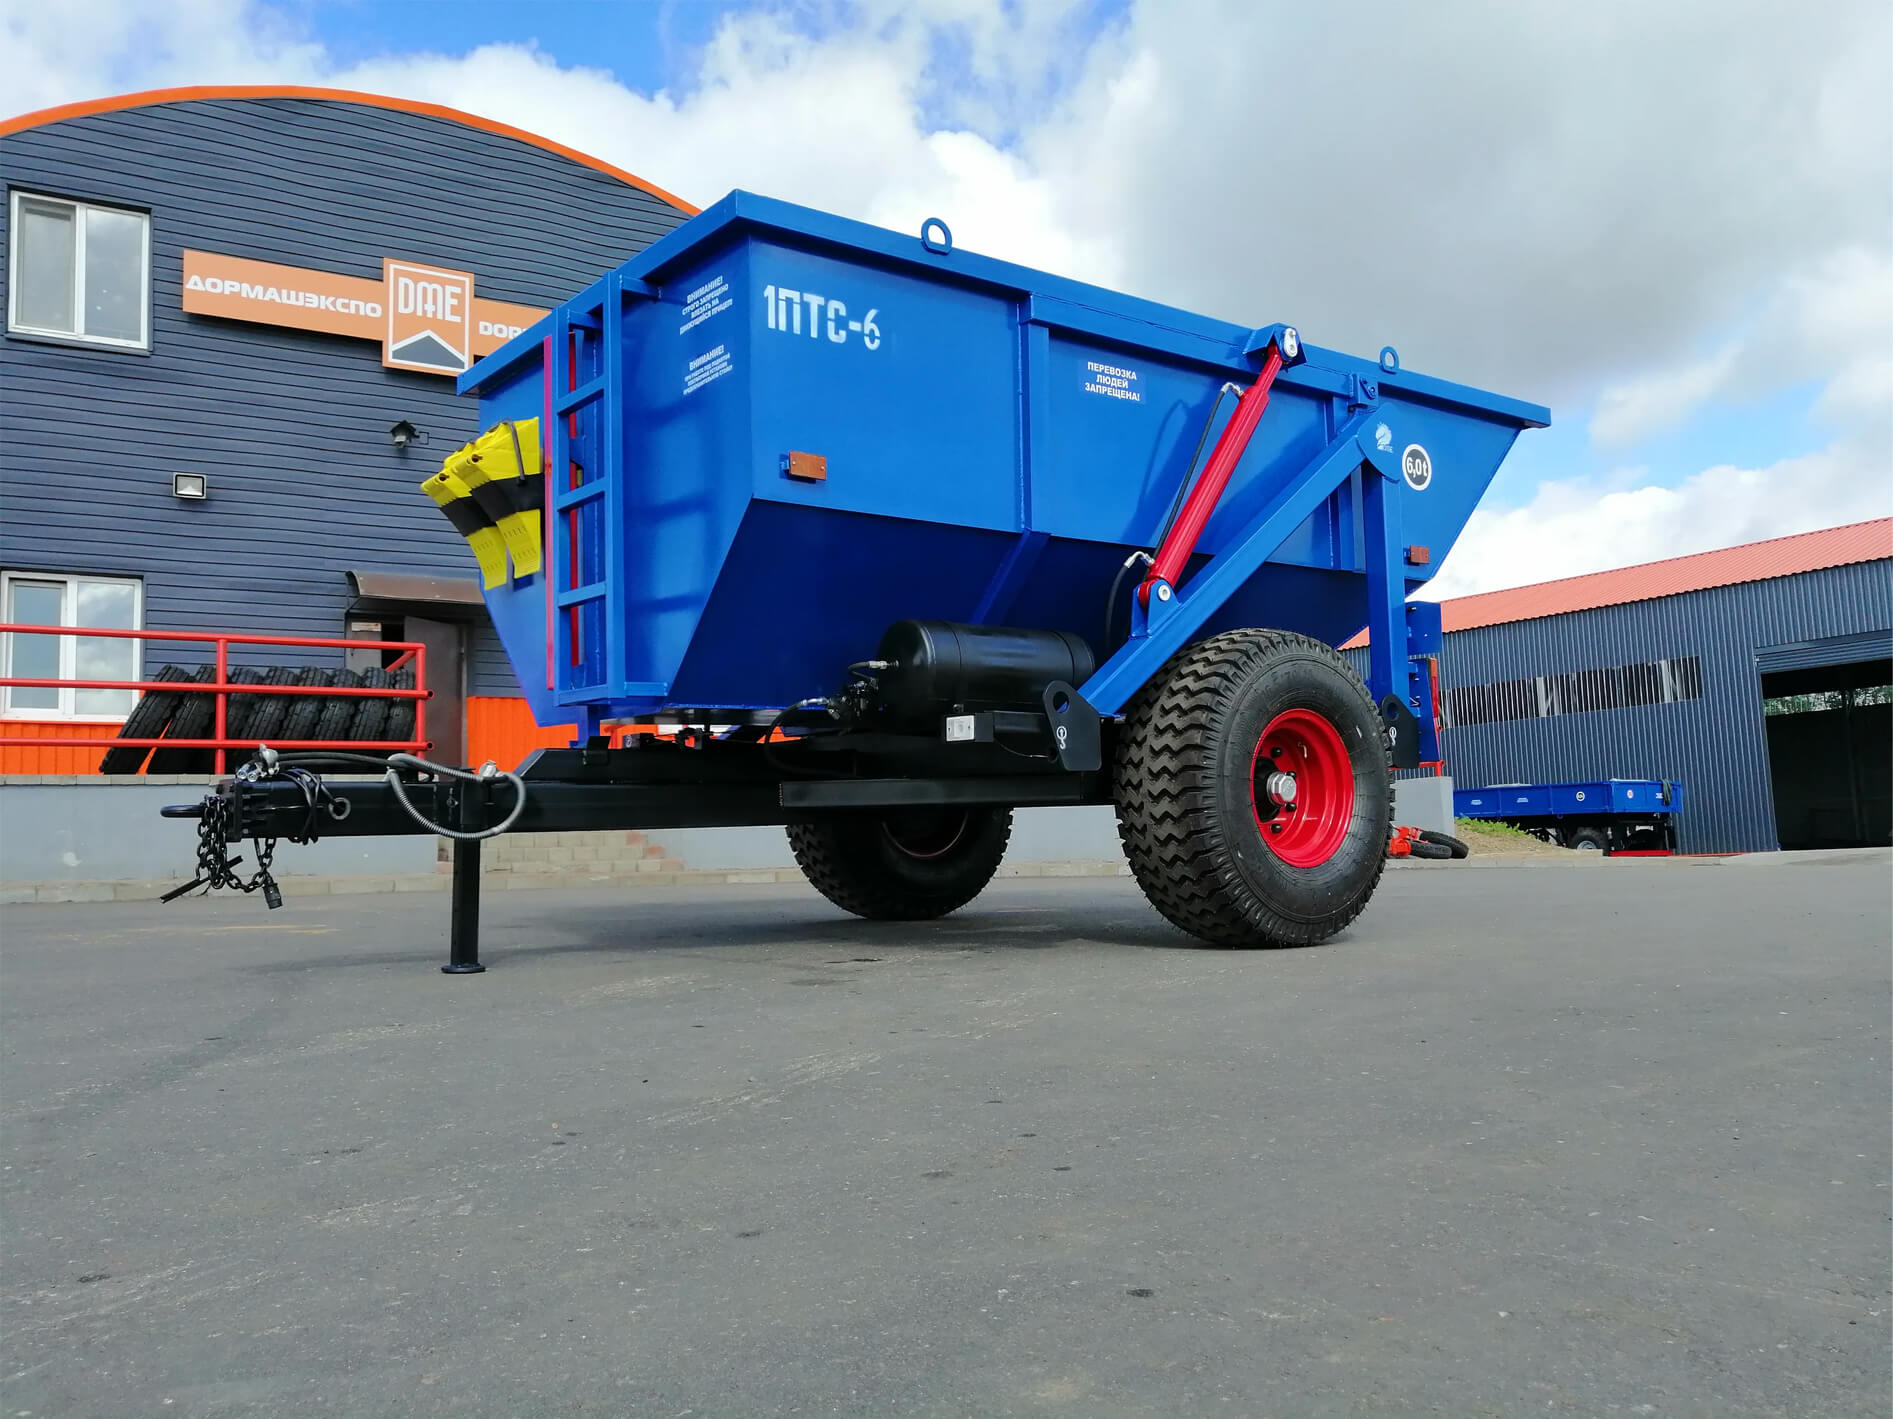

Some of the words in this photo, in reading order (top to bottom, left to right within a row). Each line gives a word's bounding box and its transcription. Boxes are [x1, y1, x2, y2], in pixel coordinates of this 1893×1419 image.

[185, 275, 382, 318] ДОРМАШЭКСПО
[763, 284, 881, 351] 1ПТС-6
[1087, 361, 1137, 380] ПЕРЕВОЗКА
[1096, 374, 1129, 389] ЛЮДЕЙ
[1084, 382, 1141, 401] ЗАПРЕЩЕНА!
